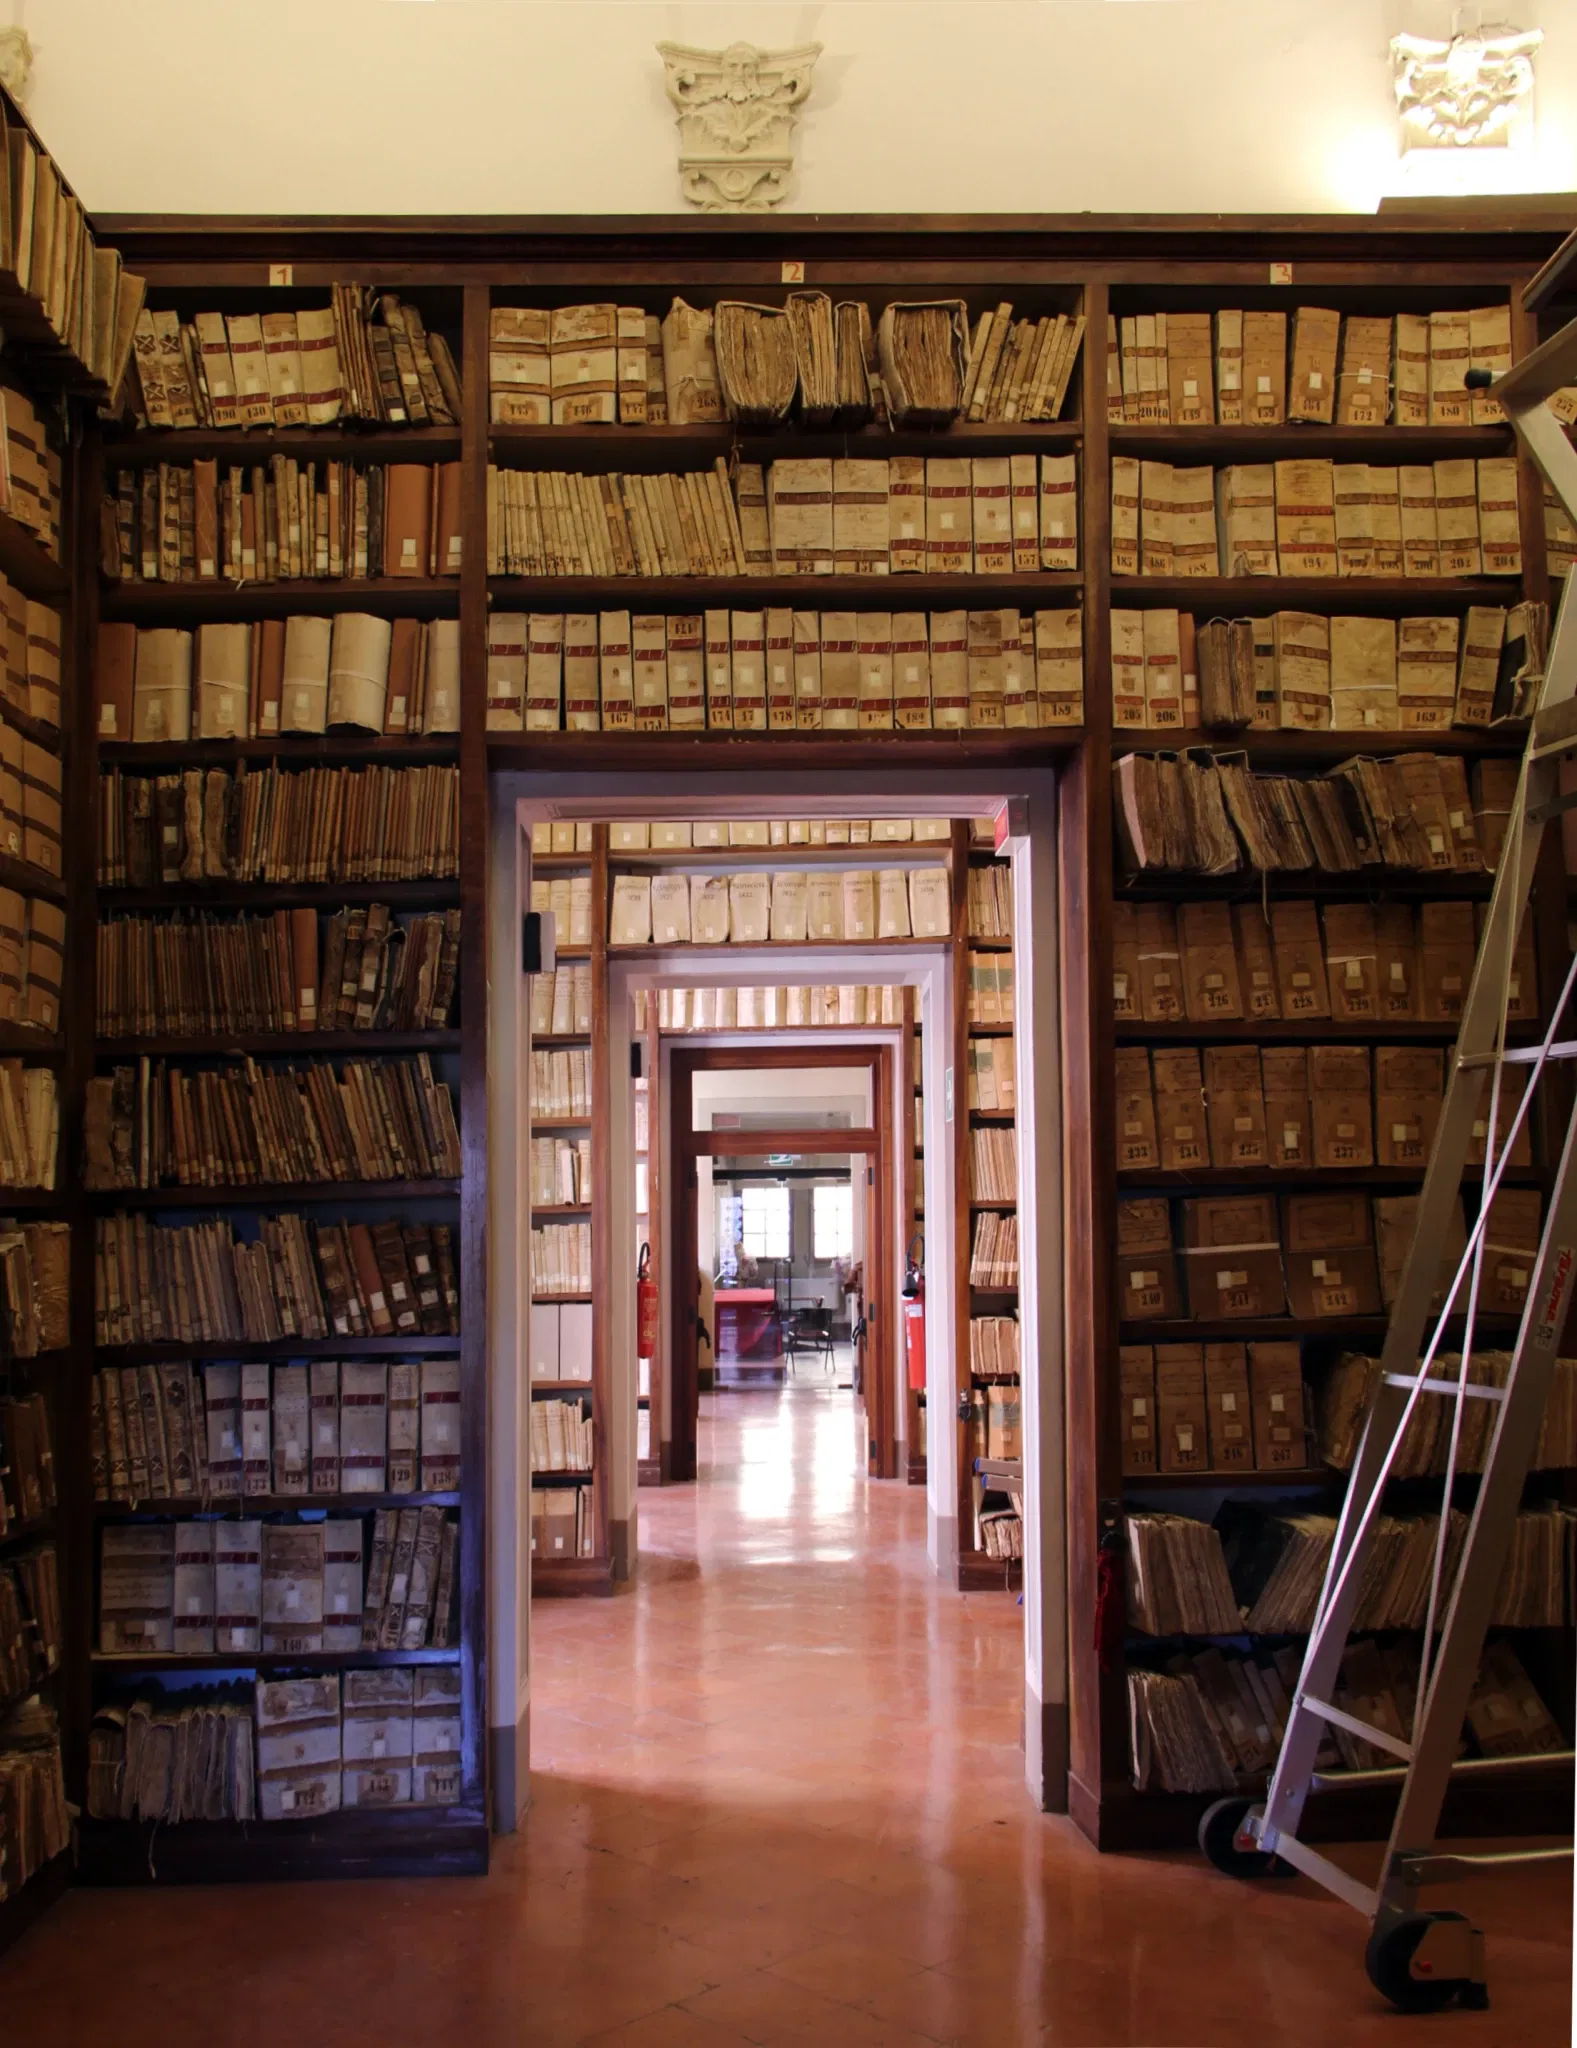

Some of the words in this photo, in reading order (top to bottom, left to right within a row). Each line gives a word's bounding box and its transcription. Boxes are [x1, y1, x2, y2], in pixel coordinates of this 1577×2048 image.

[277, 268, 288, 286] 1
[785, 264, 802, 281] 2
[1276, 264, 1291, 283] 3
[1440, 406, 1460, 417] 180
[1018, 554, 1036, 566] 157
[611, 713, 629, 725] 167
[773, 711, 793, 723] 178
[1123, 708, 1141, 721] 205
[1156, 711, 1176, 723] 206
[391, 1469, 410, 1482] 129
